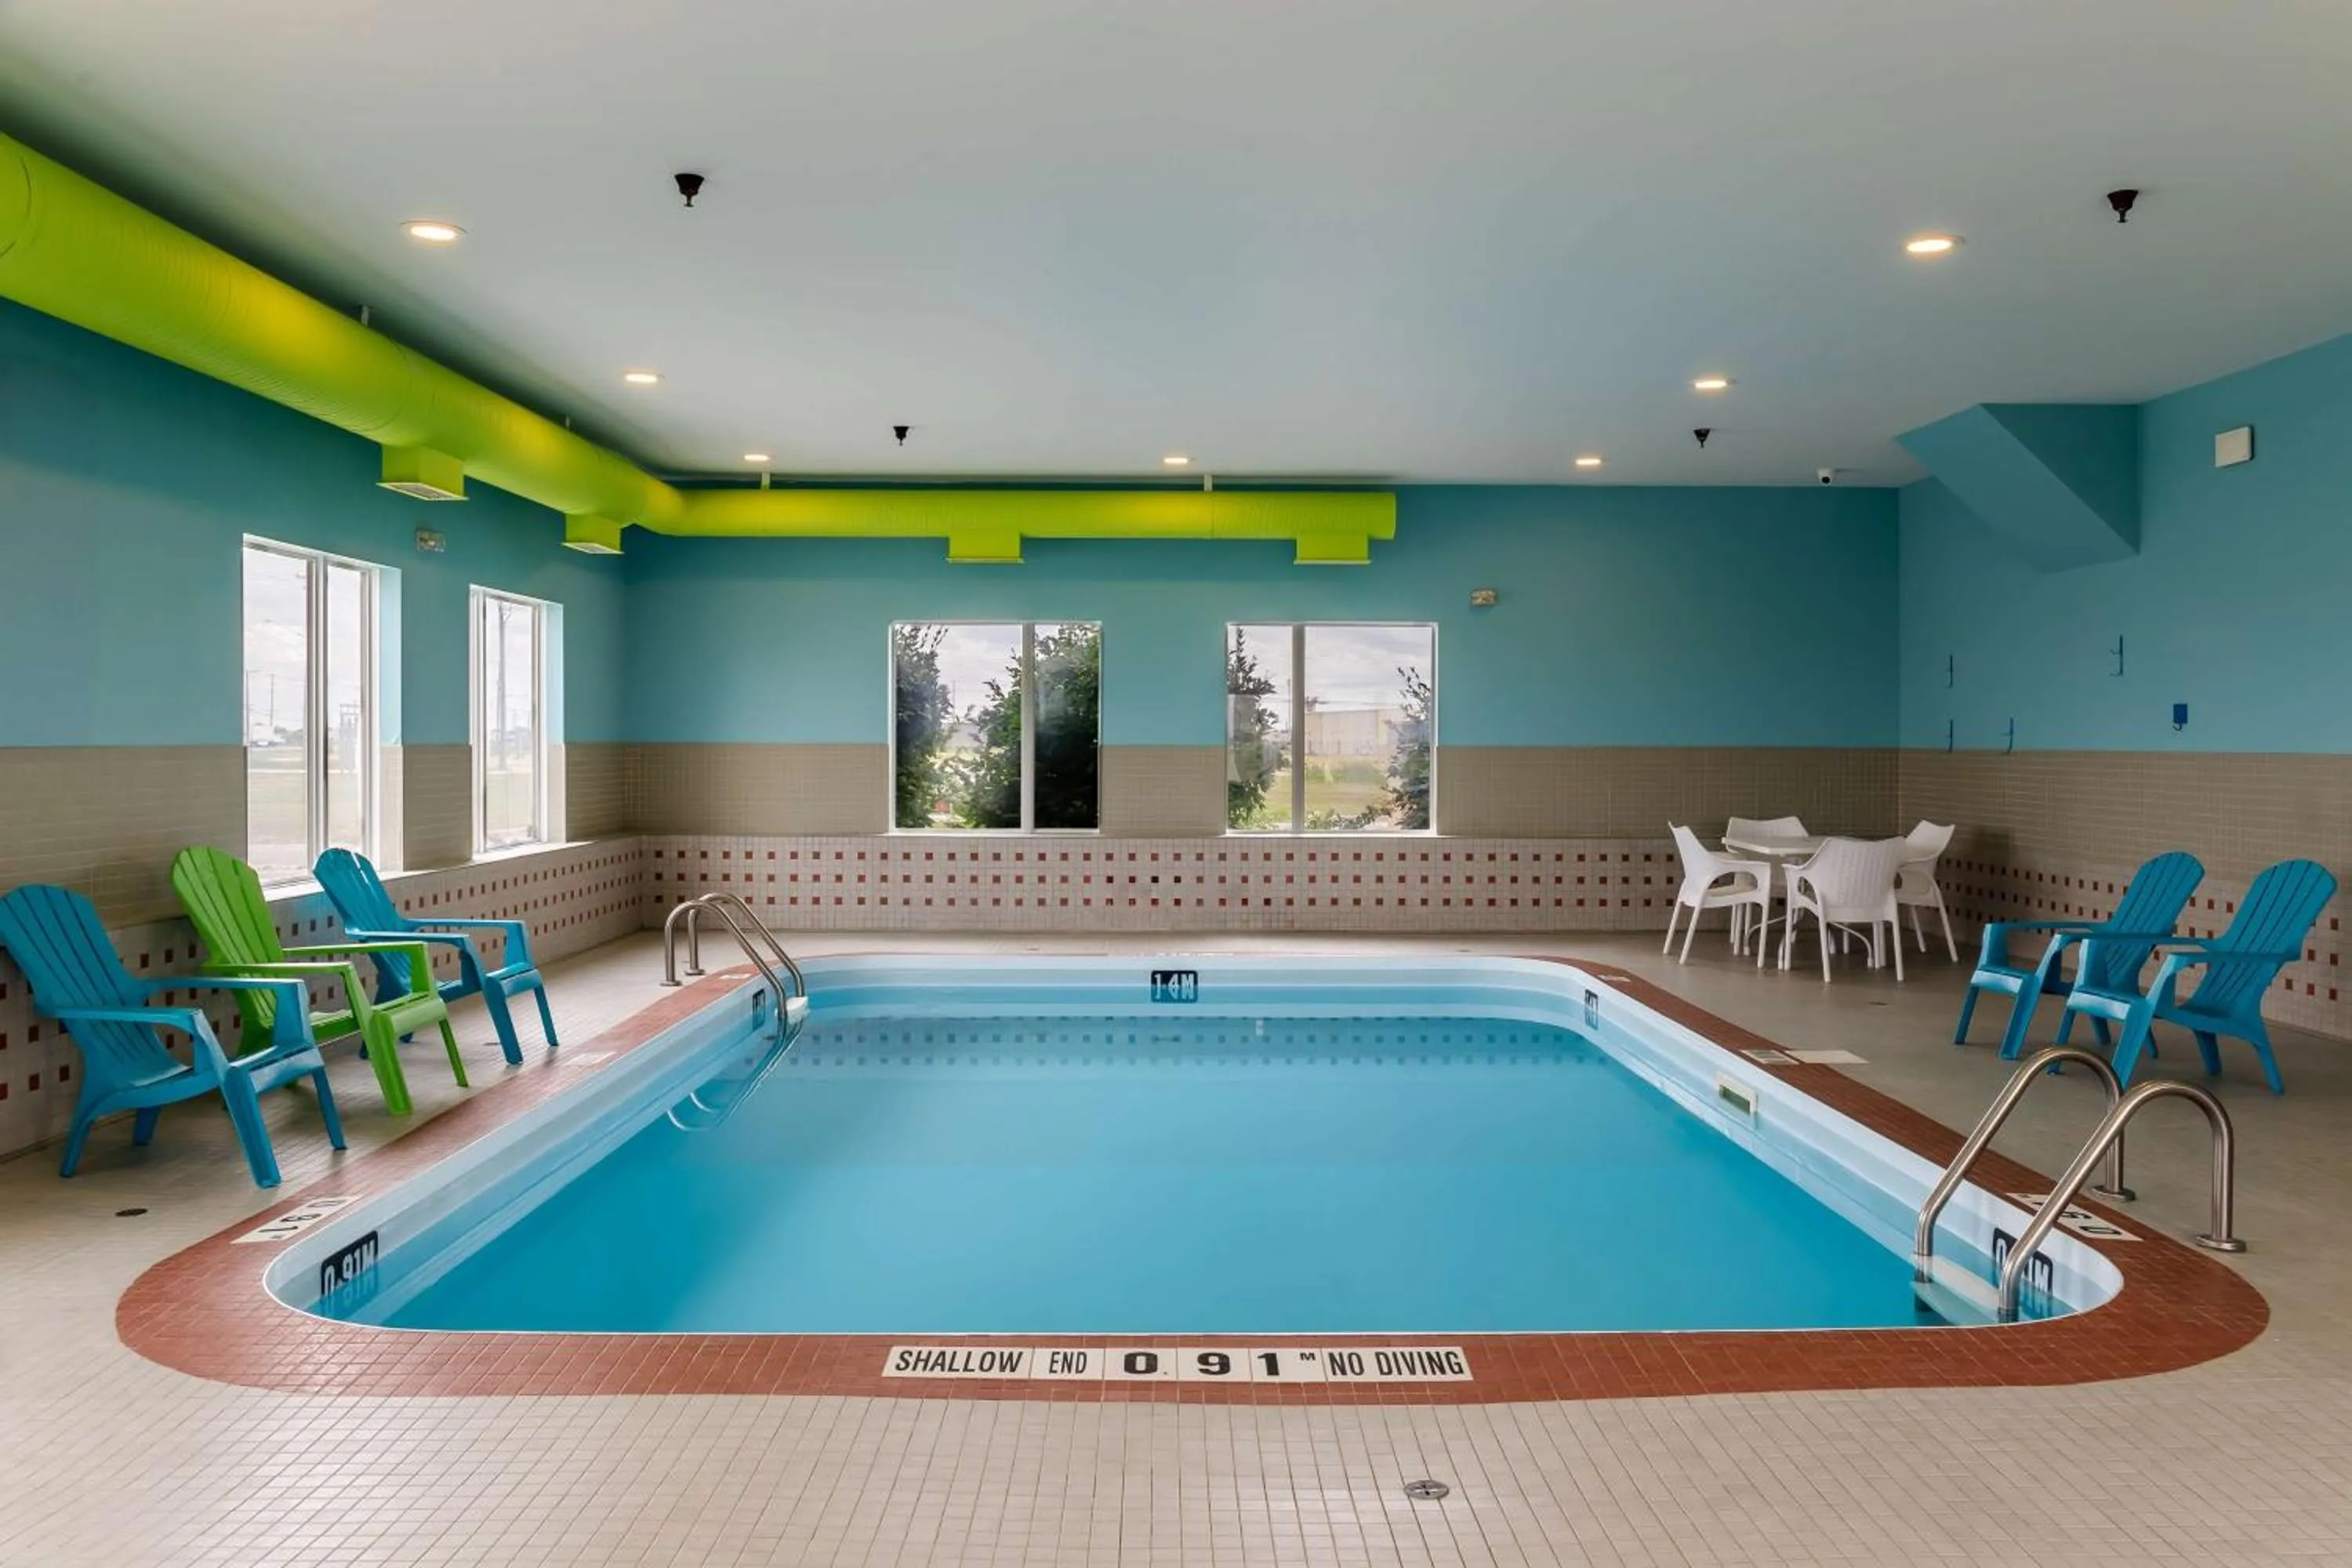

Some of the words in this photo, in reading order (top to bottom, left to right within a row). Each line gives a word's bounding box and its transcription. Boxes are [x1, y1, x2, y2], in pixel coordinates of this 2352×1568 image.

[895, 1350, 1023, 1373] SHALLOW
[1049, 1352, 1087, 1374] END
[1328, 1352, 1365, 1376] NO
[1374, 1351, 1464, 1376] DIVING
